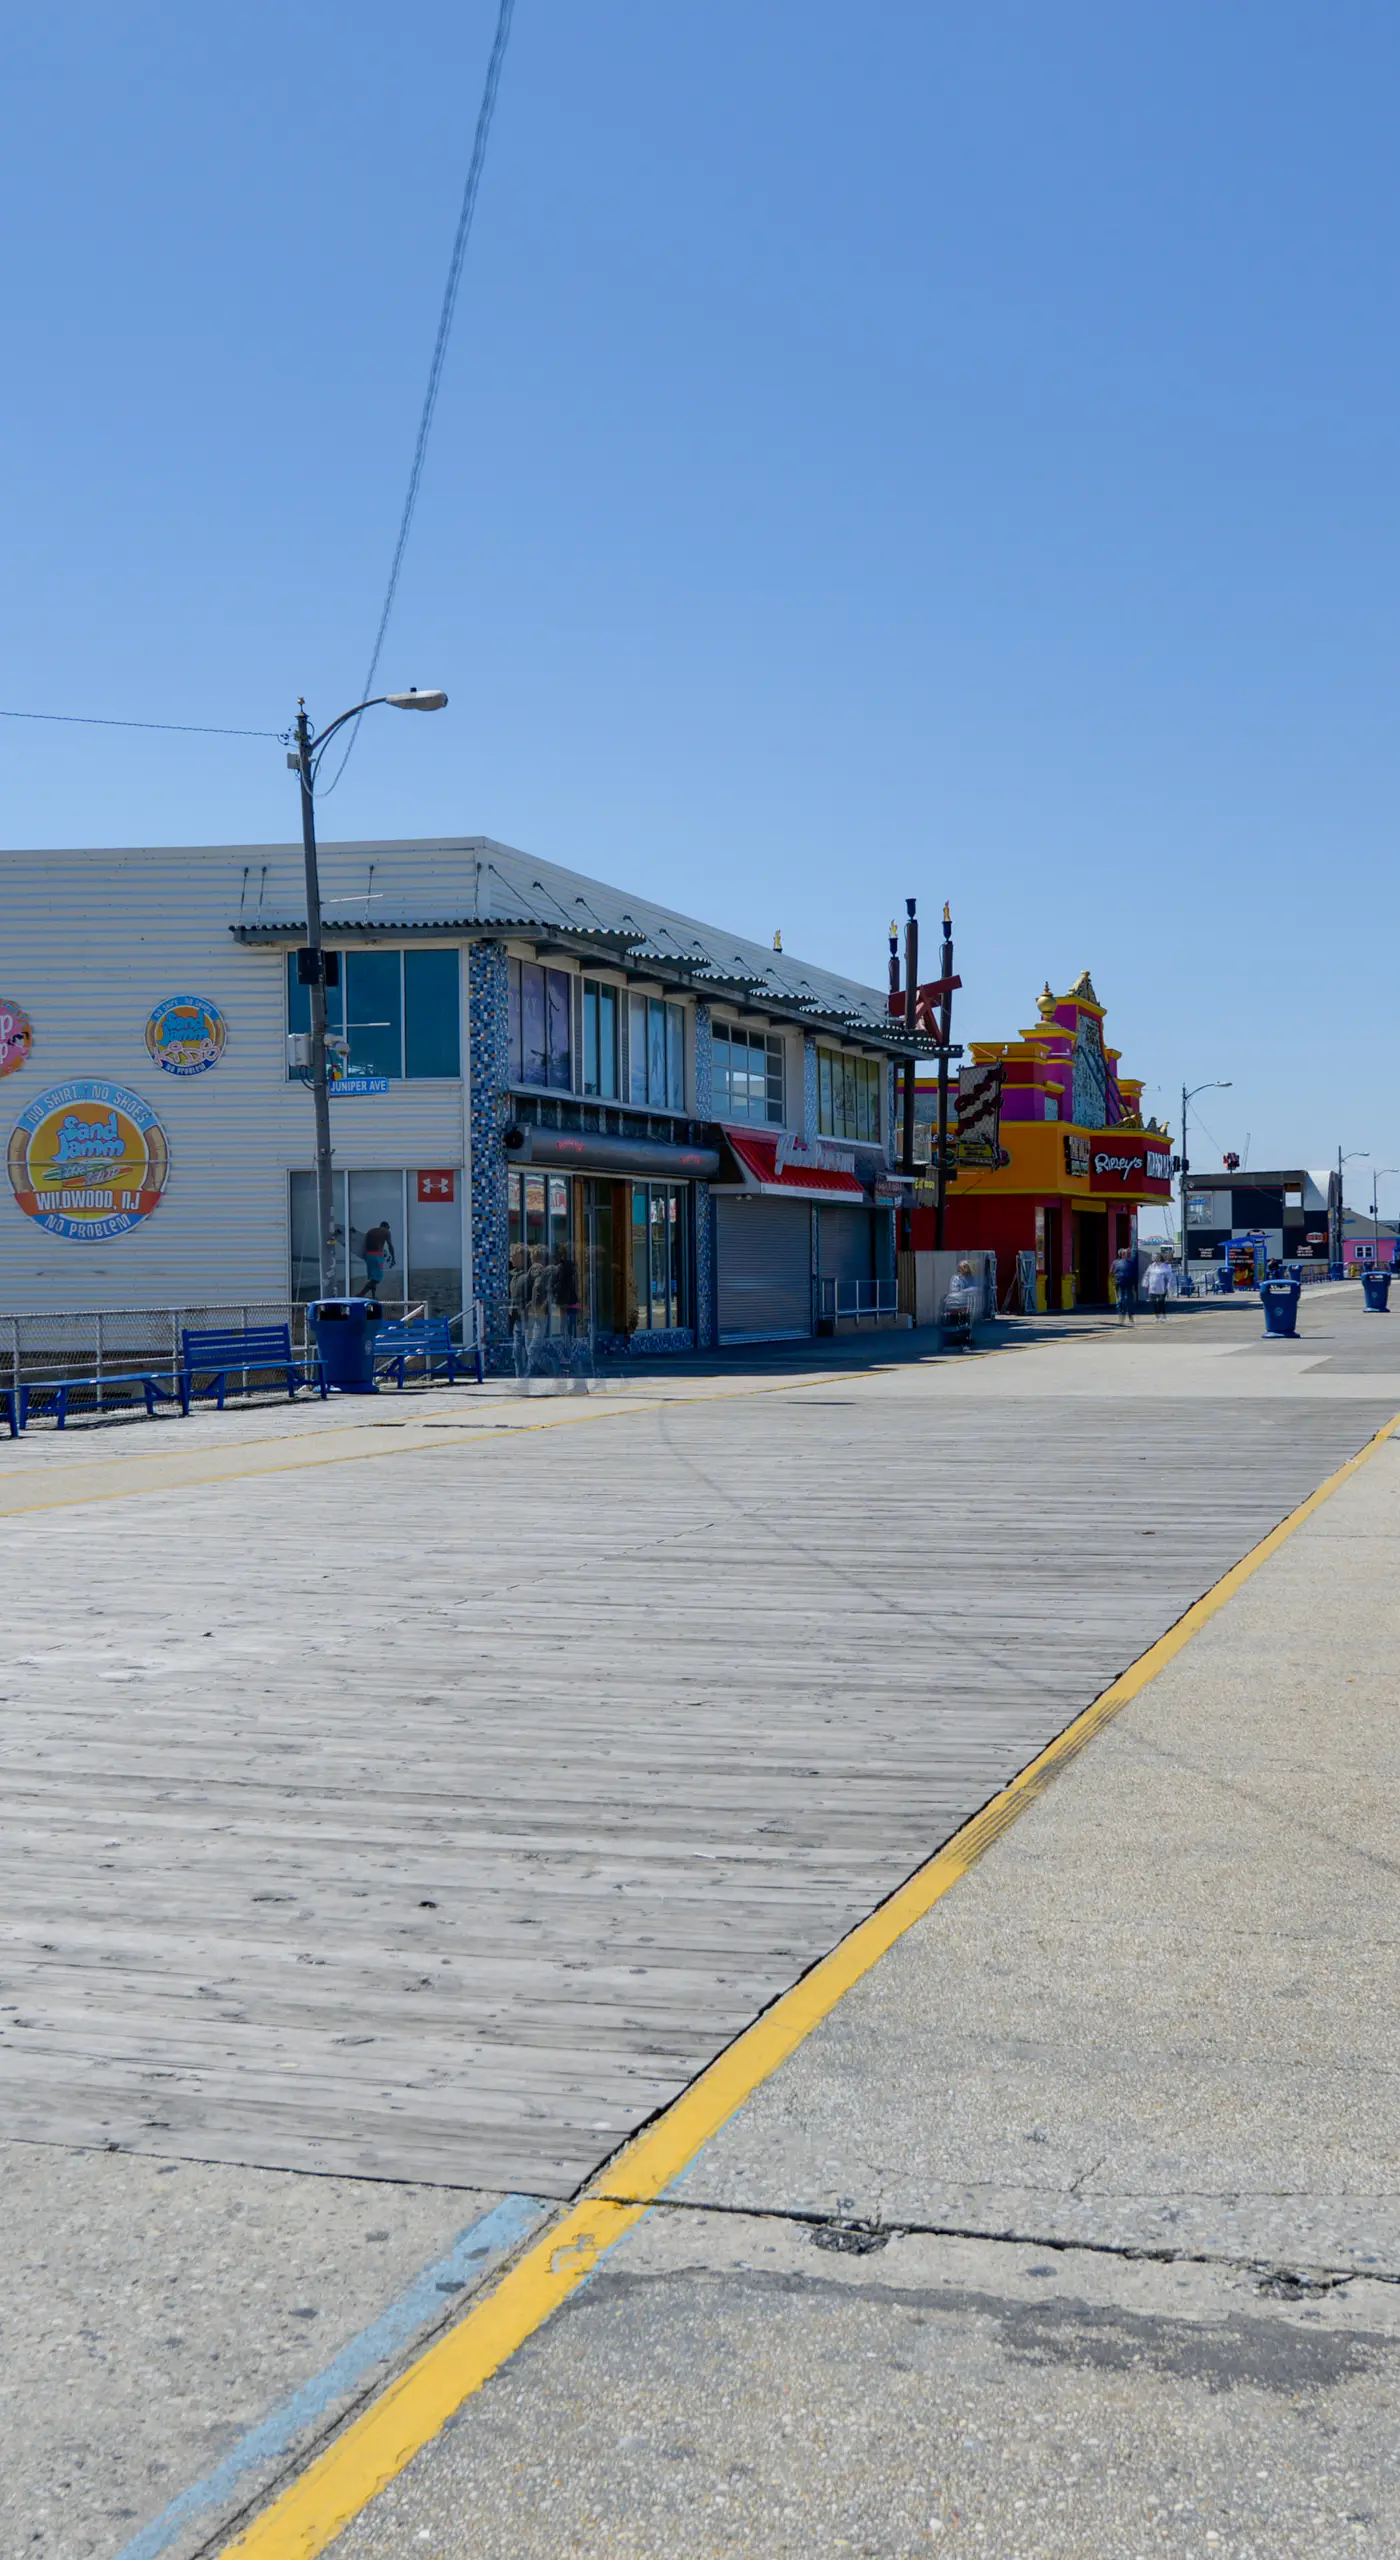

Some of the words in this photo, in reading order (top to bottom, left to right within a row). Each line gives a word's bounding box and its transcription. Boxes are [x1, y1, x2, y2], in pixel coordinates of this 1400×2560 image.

[330, 1080, 367, 1092] JUNIPER
[369, 1080, 386, 1091] AVE
[25, 1105, 43, 1124] NO
[91, 1085, 110, 1099] NO
[113, 1091, 149, 1124] SHOES
[62, 1111, 118, 1141] Sand
[51, 1133, 125, 1163] Jamm
[36, 1190, 117, 1211] WILDWOOD,
[45, 1214, 64, 1232] NO
